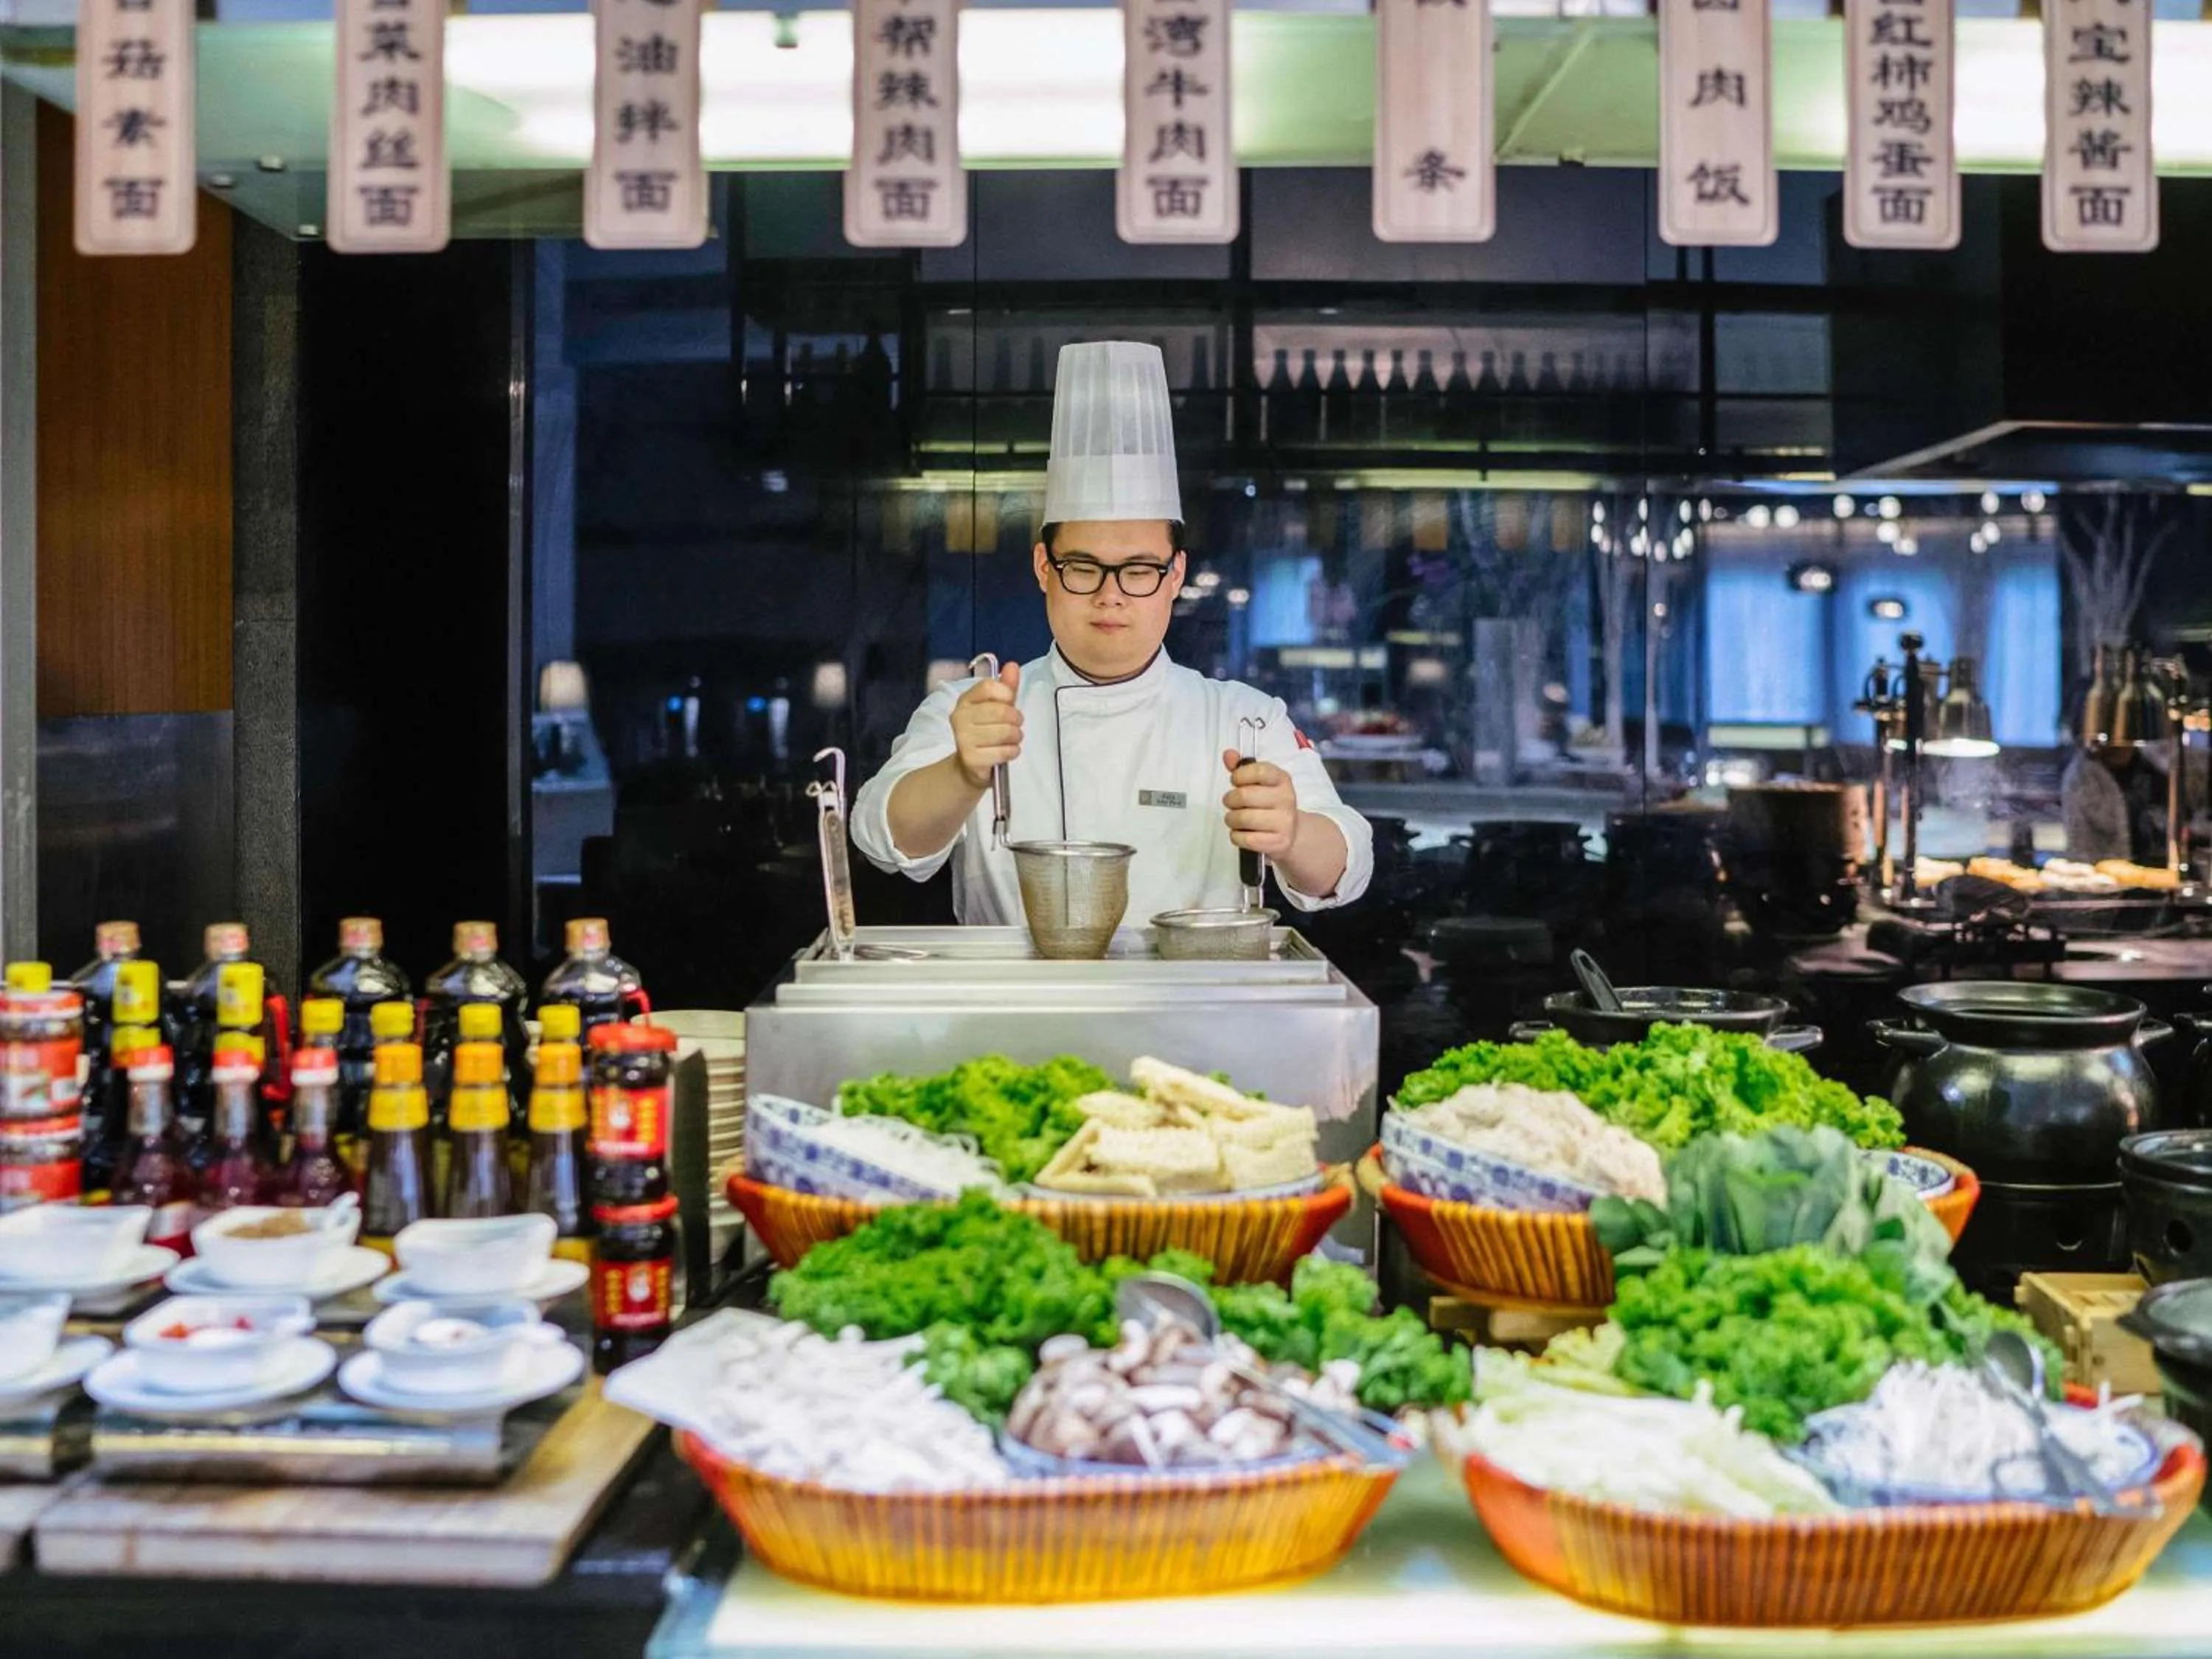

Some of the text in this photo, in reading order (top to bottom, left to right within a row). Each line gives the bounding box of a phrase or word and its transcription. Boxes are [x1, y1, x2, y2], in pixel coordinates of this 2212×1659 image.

[102, 0, 166, 220] 菇素面
[359, 0, 424, 226] 菜肉丝面
[615, 0, 681, 211] 油拌面
[873, 0, 938, 220] 帮辣肉面
[1142, 0, 1210, 218] 湾牛肉面
[1868, 0, 1935, 226] 红柿鸡蛋面
[2067, 0, 2132, 226] 宝辣酱面
